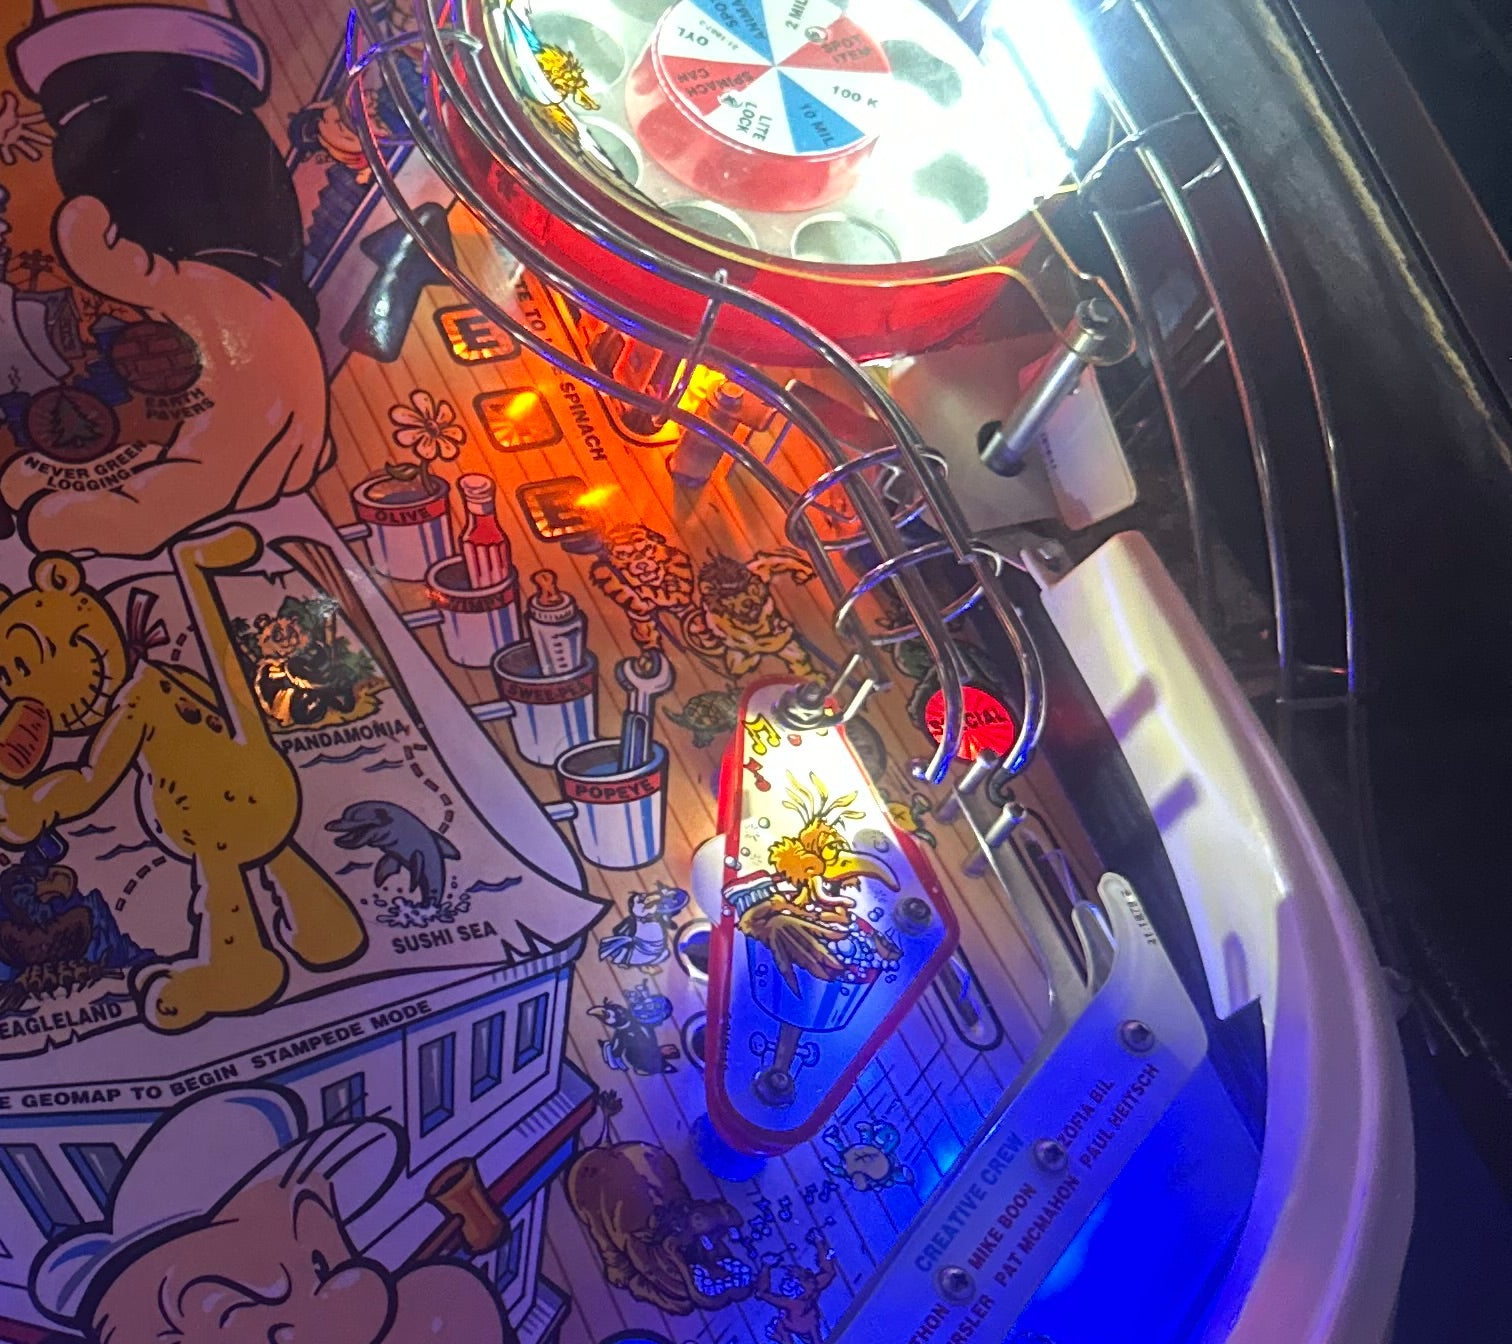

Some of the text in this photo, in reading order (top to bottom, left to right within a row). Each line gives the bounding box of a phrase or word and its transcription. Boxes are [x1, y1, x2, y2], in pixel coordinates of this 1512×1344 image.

[676, 26, 709, 47] OYL
[784, 19, 799, 31] 2
[820, 33, 863, 54] SPOT
[832, 46, 872, 64] ITEM
[677, 66, 711, 84] CAN
[687, 70, 754, 98] SPINACH
[831, 84, 880, 109] 100 K
[734, 100, 758, 135] LOCK
[752, 114, 774, 143] LITE
[799, 102, 836, 147] 10 MIL
[525, 308, 547, 332] TO
[144, 387, 206, 408] EARTH
[145, 397, 215, 420] PAVERS
[559, 380, 609, 462] SPINACH
[24, 439, 147, 480] NEVER GREEN
[46, 468, 131, 492] LOGGING
[375, 507, 429, 524] OLIVE
[281, 719, 408, 753] PANDAMONIA
[575, 779, 655, 800] POPEYE
[392, 920, 498, 954] SUSHI SEA
[20, 1087, 122, 1110] GEOMAP
[129, 1084, 164, 1102] TO
[169, 1064, 240, 1097] BEGIN
[249, 1022, 365, 1069] STAMPEDE
[369, 1000, 432, 1032] MODE
[967, 1226, 1006, 1272] MIKE
[996, 1182, 1039, 1230] BOON
[1089, 1078, 1116, 1105] BIL
[914, 1130, 1027, 1274] CREATIVE CREW
[992, 1251, 1024, 1289] PAT
[1016, 1174, 1081, 1257] MCMAHON
[1078, 1128, 1116, 1169] PAUL
